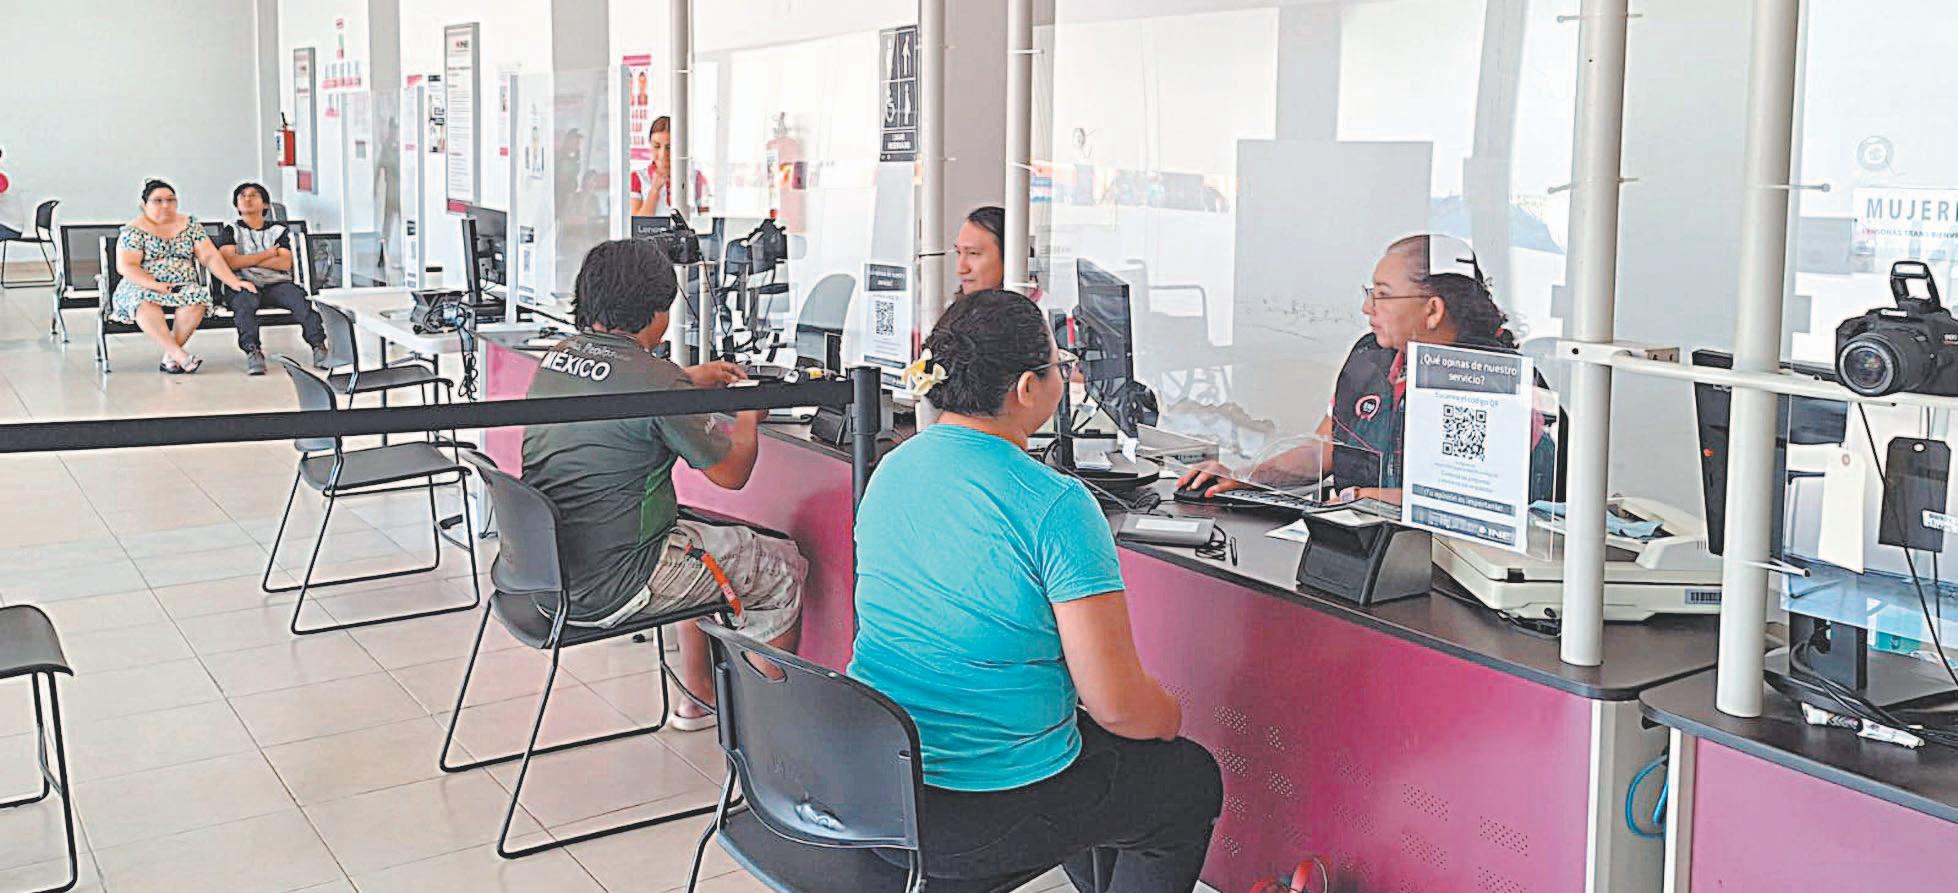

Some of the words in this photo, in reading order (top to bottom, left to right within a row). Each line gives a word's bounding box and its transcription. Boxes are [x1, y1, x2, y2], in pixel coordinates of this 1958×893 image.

[638, 225, 667, 234] Leno
[541, 349, 611, 381] MÉXICO
[1420, 353, 1441, 366] ¿Qué
[1441, 357, 1470, 369] opinas
[1471, 361, 1483, 371] de
[1483, 364, 1518, 376] nuestro
[1448, 373, 1486, 385] servicio?
[1488, 529, 1512, 540] INE
